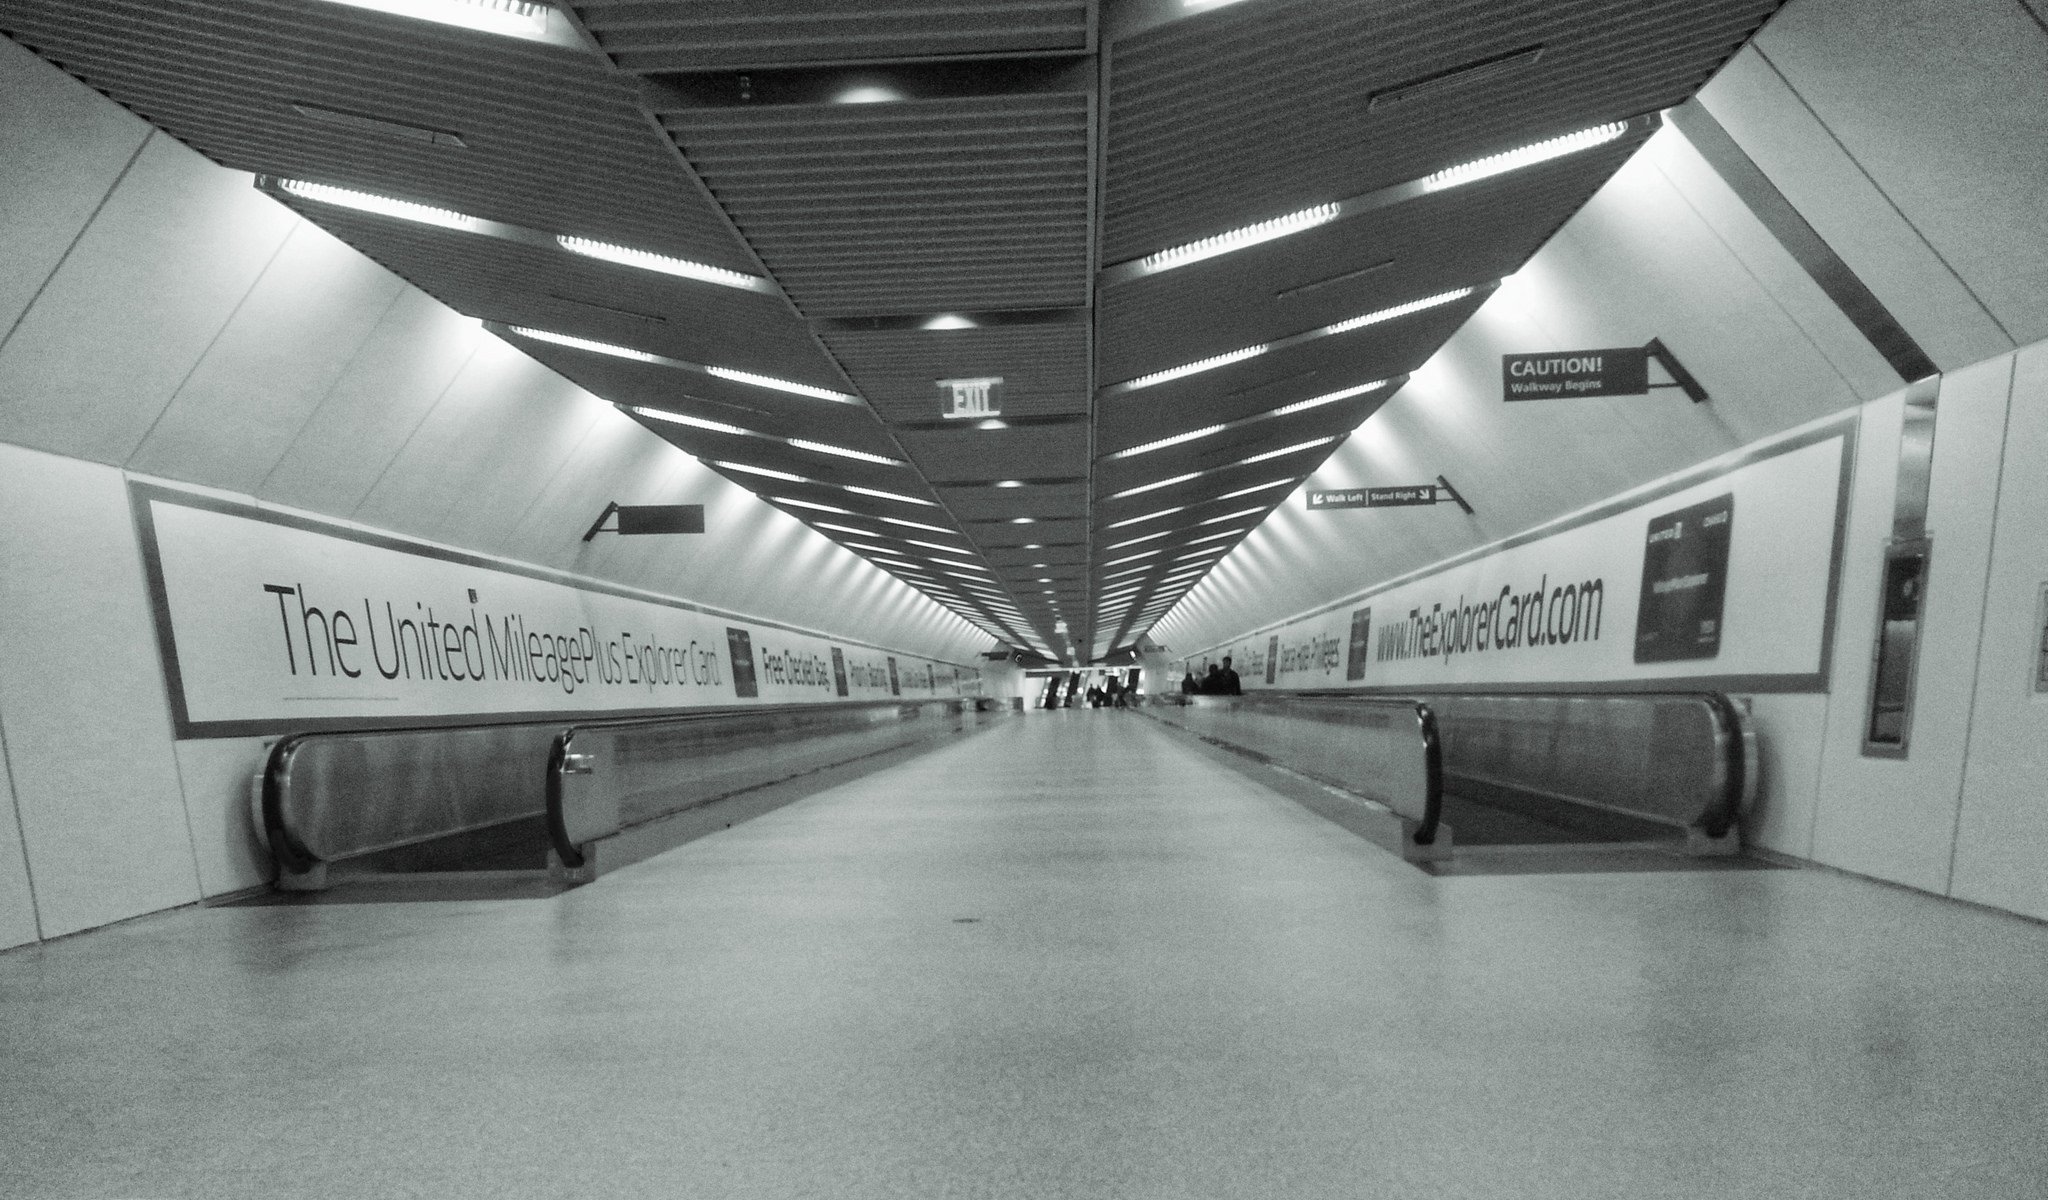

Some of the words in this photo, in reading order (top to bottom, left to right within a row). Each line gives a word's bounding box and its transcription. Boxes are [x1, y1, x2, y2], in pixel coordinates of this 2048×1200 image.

[1510, 357, 1602, 377] CAUTION!
[952, 382, 991, 416] EXIT
[1510, 381, 1561, 394] Walkway
[1565, 379, 1601, 391] Begins
[1326, 494, 1346, 503] Walk
[1347, 493, 1363, 502] Left
[1371, 492, 1394, 501] Stand
[1395, 491, 1416, 501] Right
[1377, 573, 1604, 666] www.TheExplorerCard.com
[263, 583, 361, 678] The
[364, 598, 486, 682] United
[485, 613, 623, 694] MileagePlus
[621, 631, 689, 694] Explorer
[762, 647, 786, 685] Free
